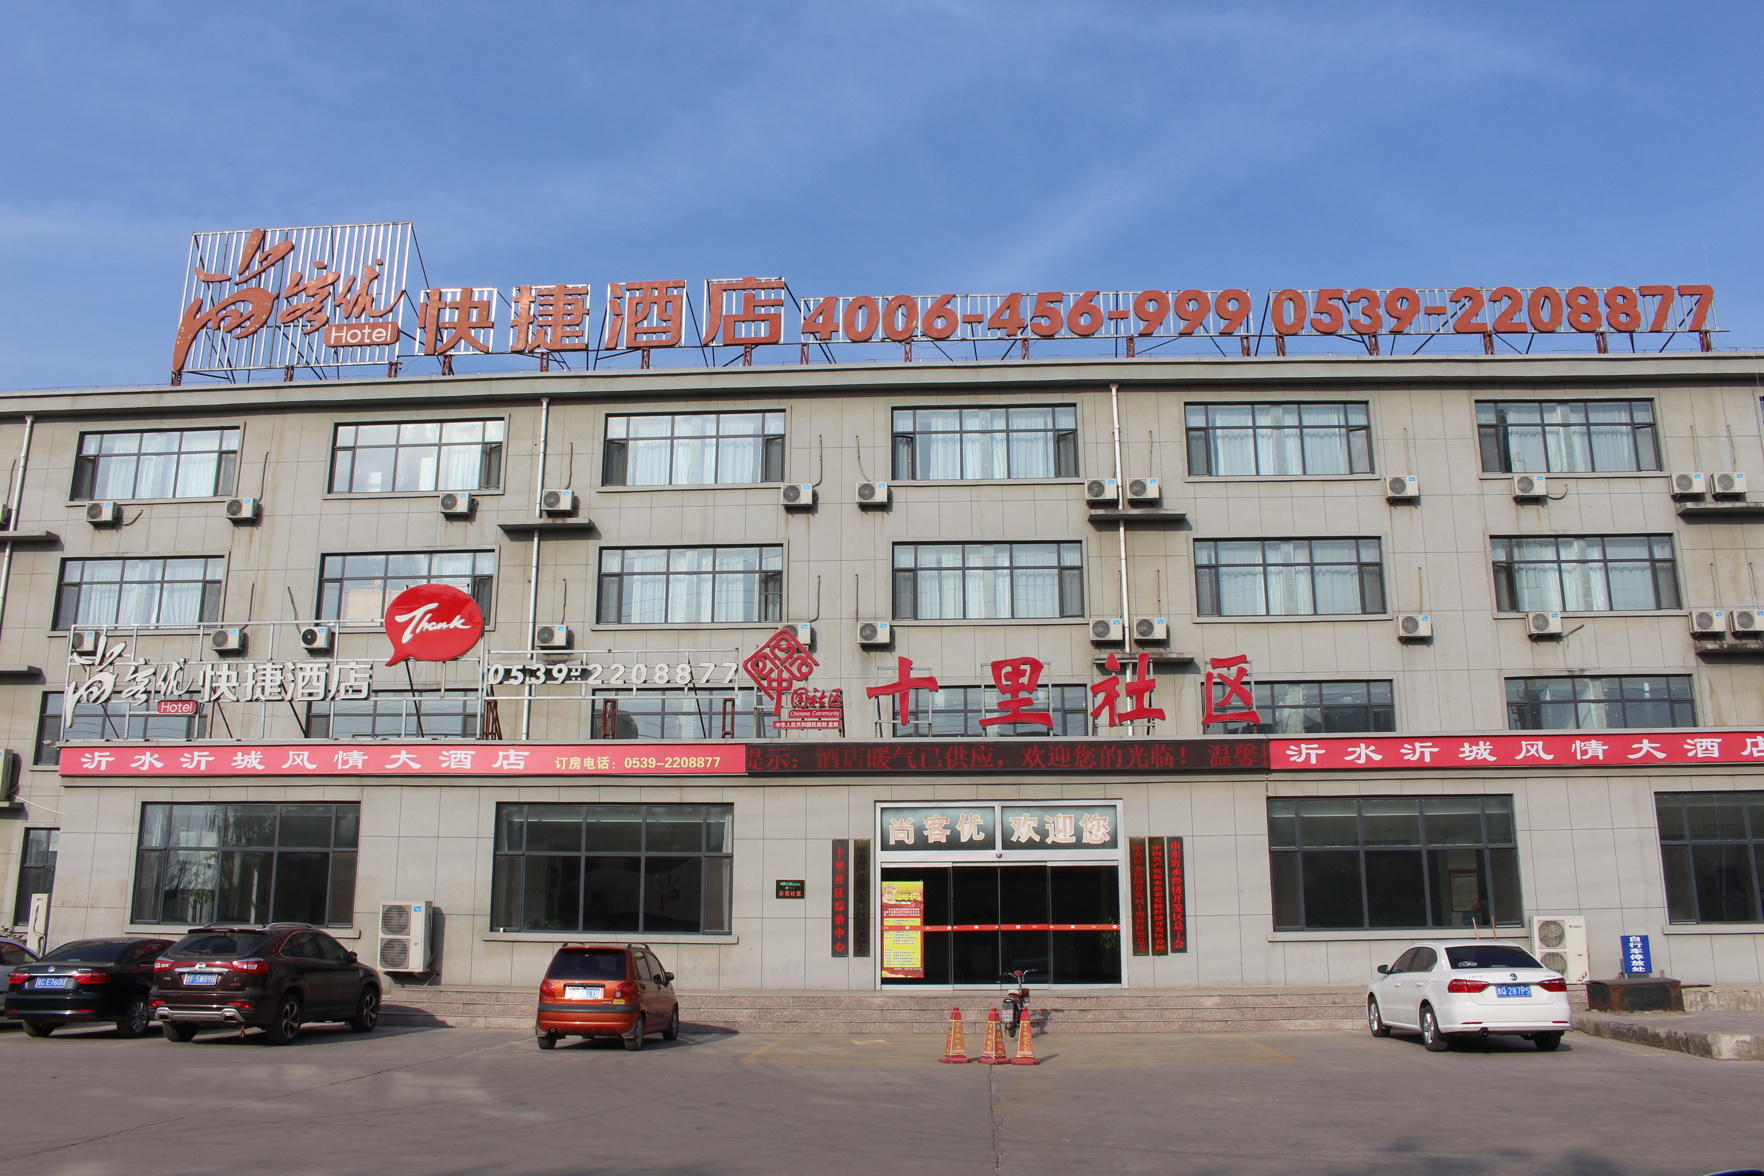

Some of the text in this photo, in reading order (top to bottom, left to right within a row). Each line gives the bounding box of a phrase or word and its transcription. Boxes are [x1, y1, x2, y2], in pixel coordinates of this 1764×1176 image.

[418, 276, 784, 355] 快捷酒店
[801, 285, 1714, 343] 4006-456-999 0539-2208877
[330, 322, 392, 345] Hotel
[395, 602, 471, 643] Thank
[200, 661, 373, 702] 快捷酒店
[488, 662, 738, 685] 0539-2208877
[865, 652, 1261, 727] 十里社区
[160, 701, 193, 714] Hotel
[80, 749, 531, 771] 沂水沂城风情大酒店
[555, 756, 721, 770] 订房电话： 0539-2208877
[1285, 735, 1764, 765] 沂水沂城风情大酒店
[889, 813, 1111, 845] 尚客优 欢迎您
[1169, 841, 1185, 949] 山东沂水经济开发区总工会
[1628, 935, 1646, 973] 自行车停放处
